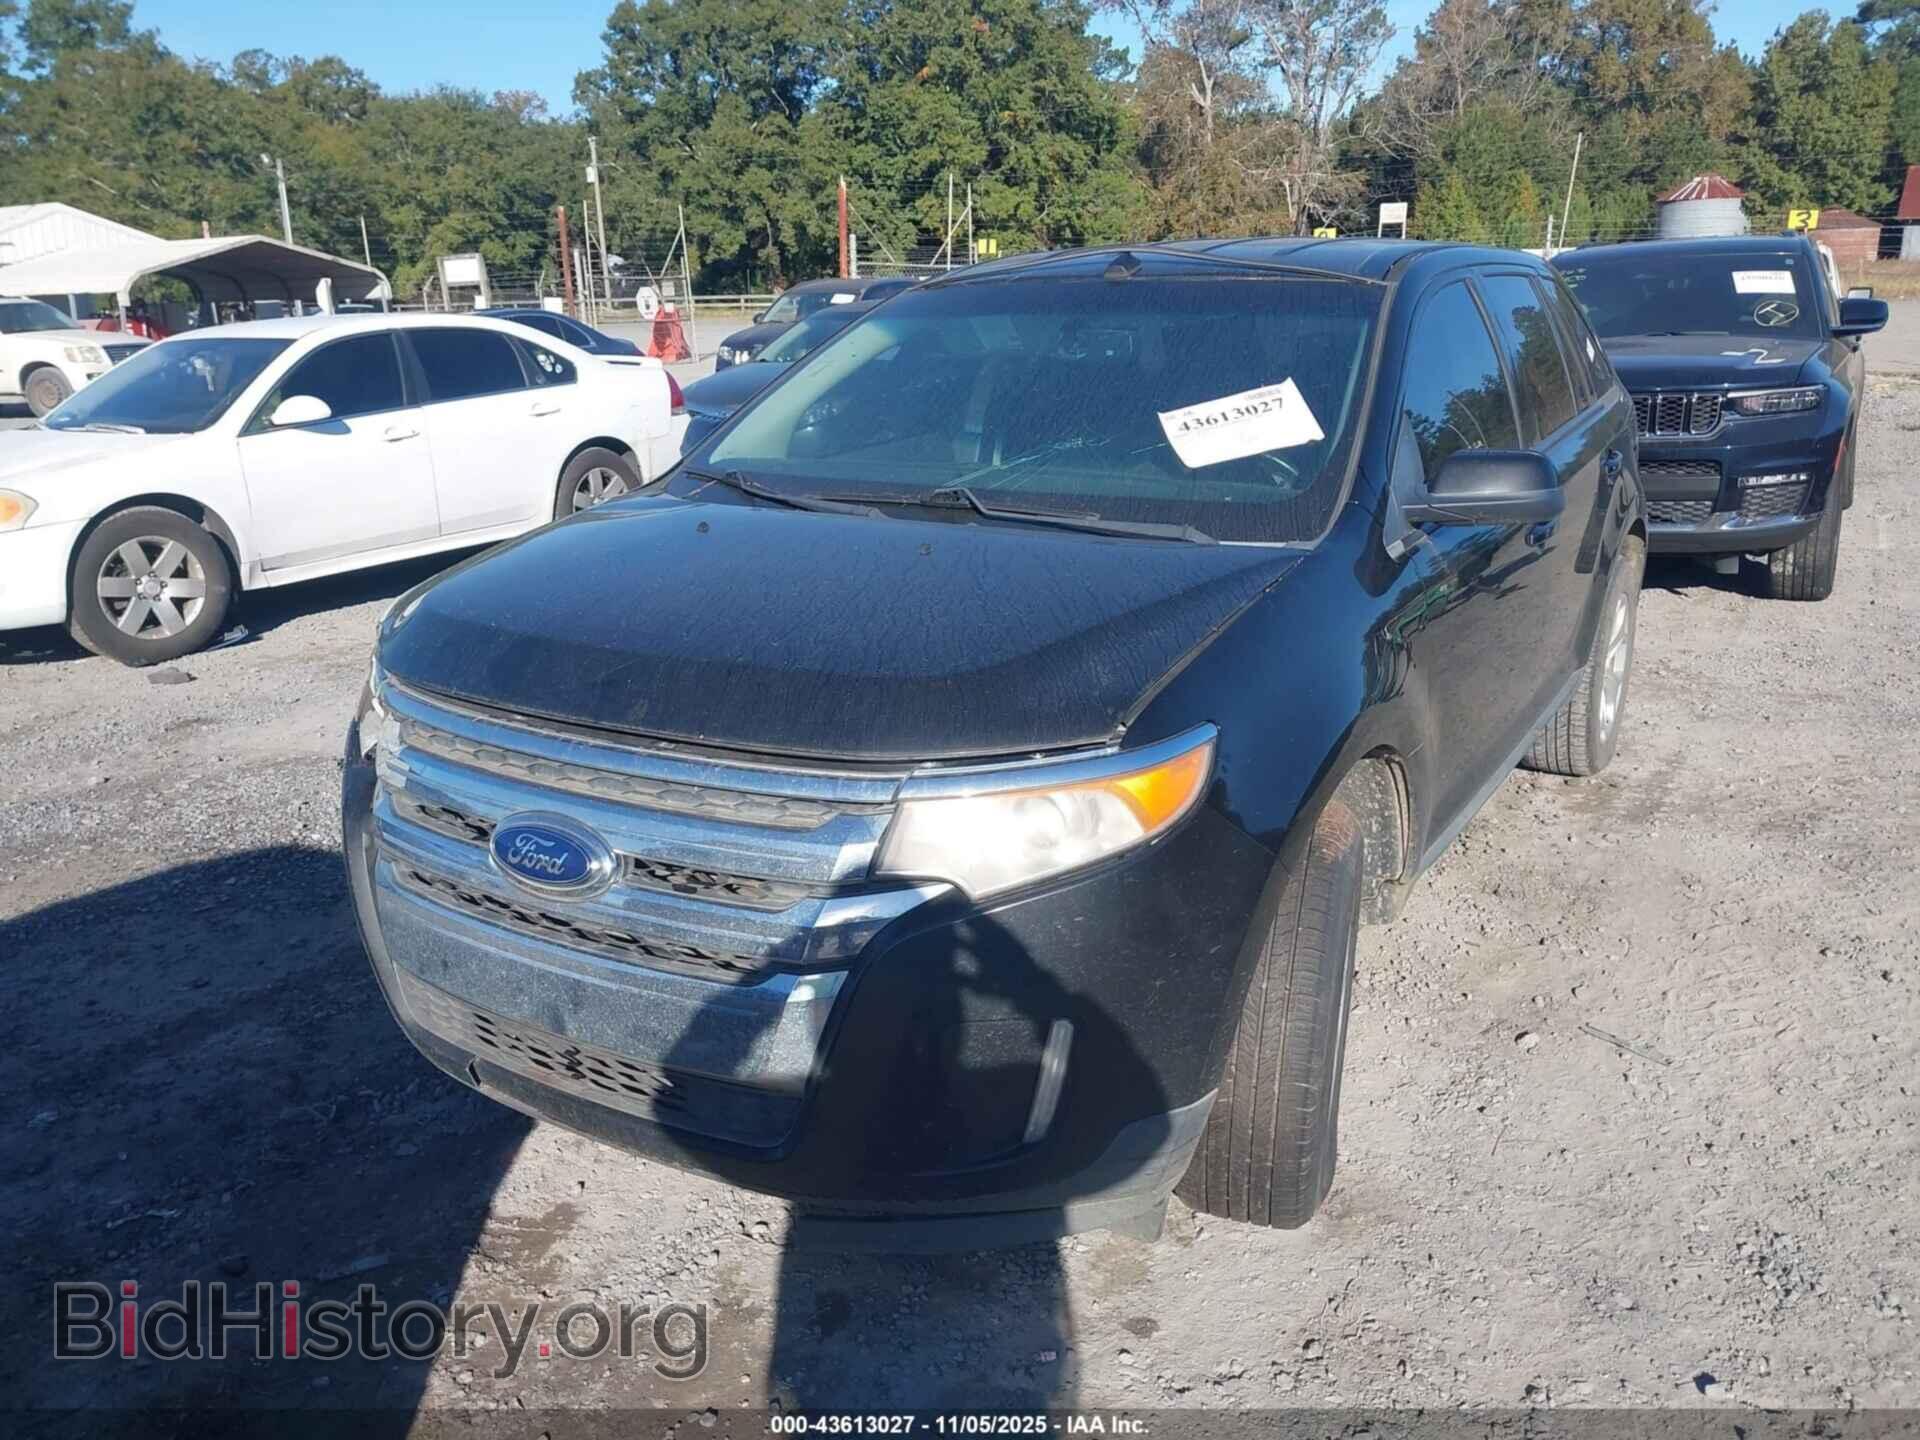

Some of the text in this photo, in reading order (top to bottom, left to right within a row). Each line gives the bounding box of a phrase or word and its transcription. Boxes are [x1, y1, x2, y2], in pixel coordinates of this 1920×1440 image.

[1794, 210, 1812, 229] 3
[1178, 397, 1283, 432] 43613027
[508, 833, 569, 875] Ford
